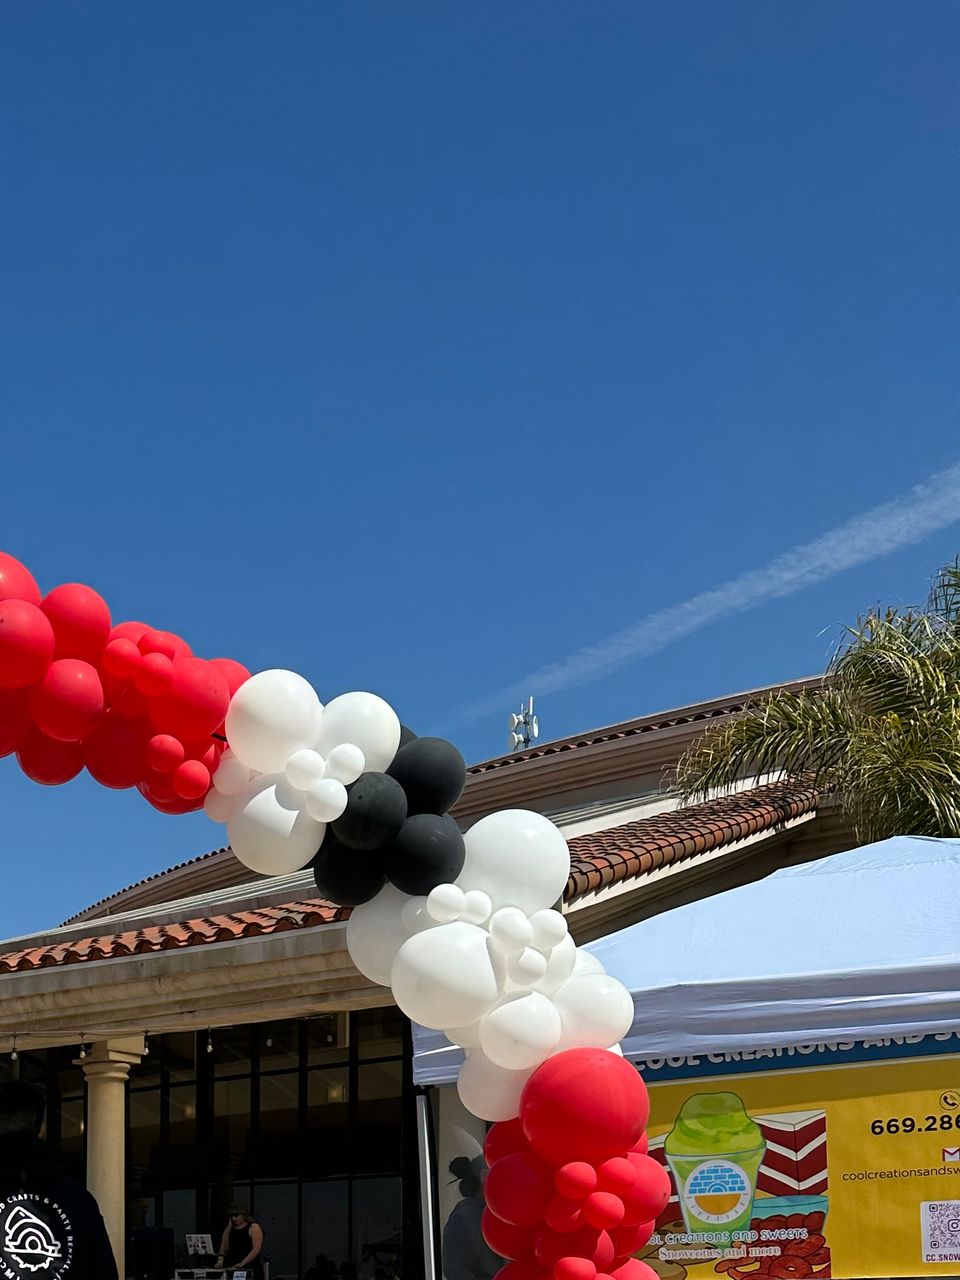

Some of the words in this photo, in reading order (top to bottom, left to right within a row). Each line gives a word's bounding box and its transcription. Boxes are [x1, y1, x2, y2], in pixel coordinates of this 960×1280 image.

[7, 1193, 40, 1204] CRAFTS
[52, 1203, 72, 1231] PARTY
[659, 1247, 722, 1261] Snowcones
[725, 1245, 746, 1259] and
[749, 1245, 781, 1258] more
